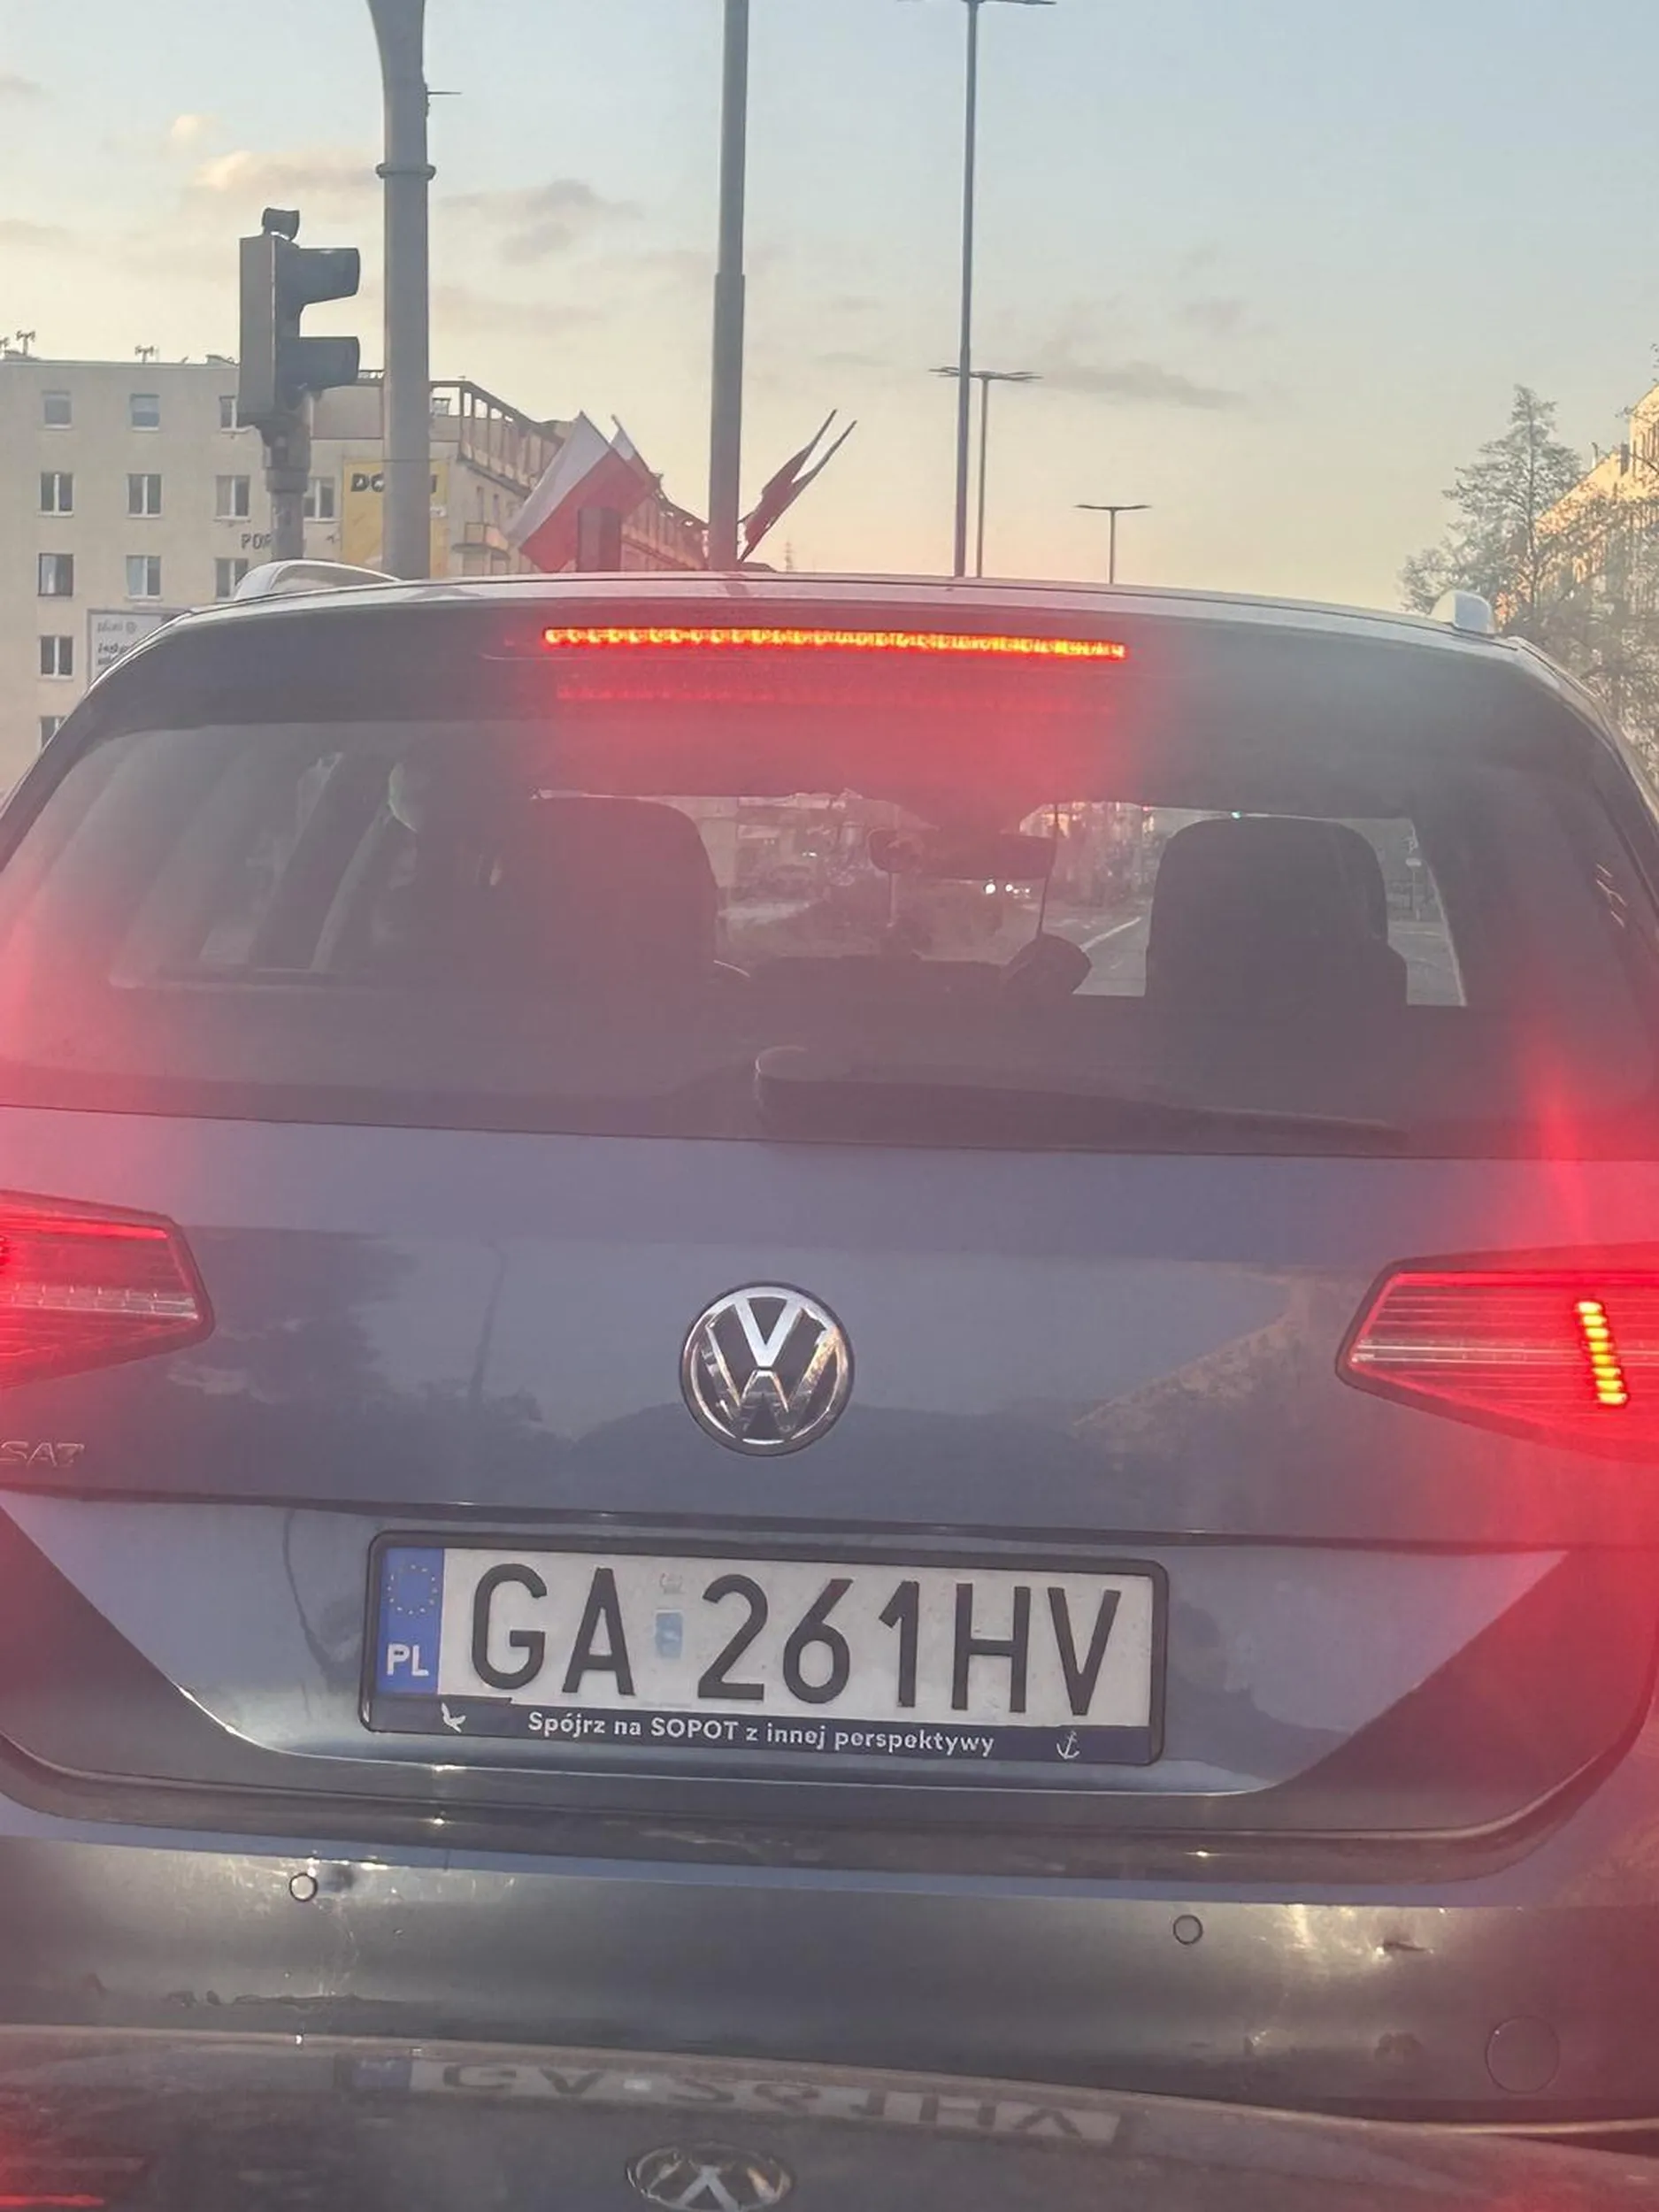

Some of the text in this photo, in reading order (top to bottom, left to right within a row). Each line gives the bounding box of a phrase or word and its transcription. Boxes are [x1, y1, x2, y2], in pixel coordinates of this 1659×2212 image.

[386, 1643, 429, 1676] PL
[472, 1563, 1122, 1717] GA 261HV
[528, 1711, 995, 1757] Spójrz na SOPOT z innej perspektywy
